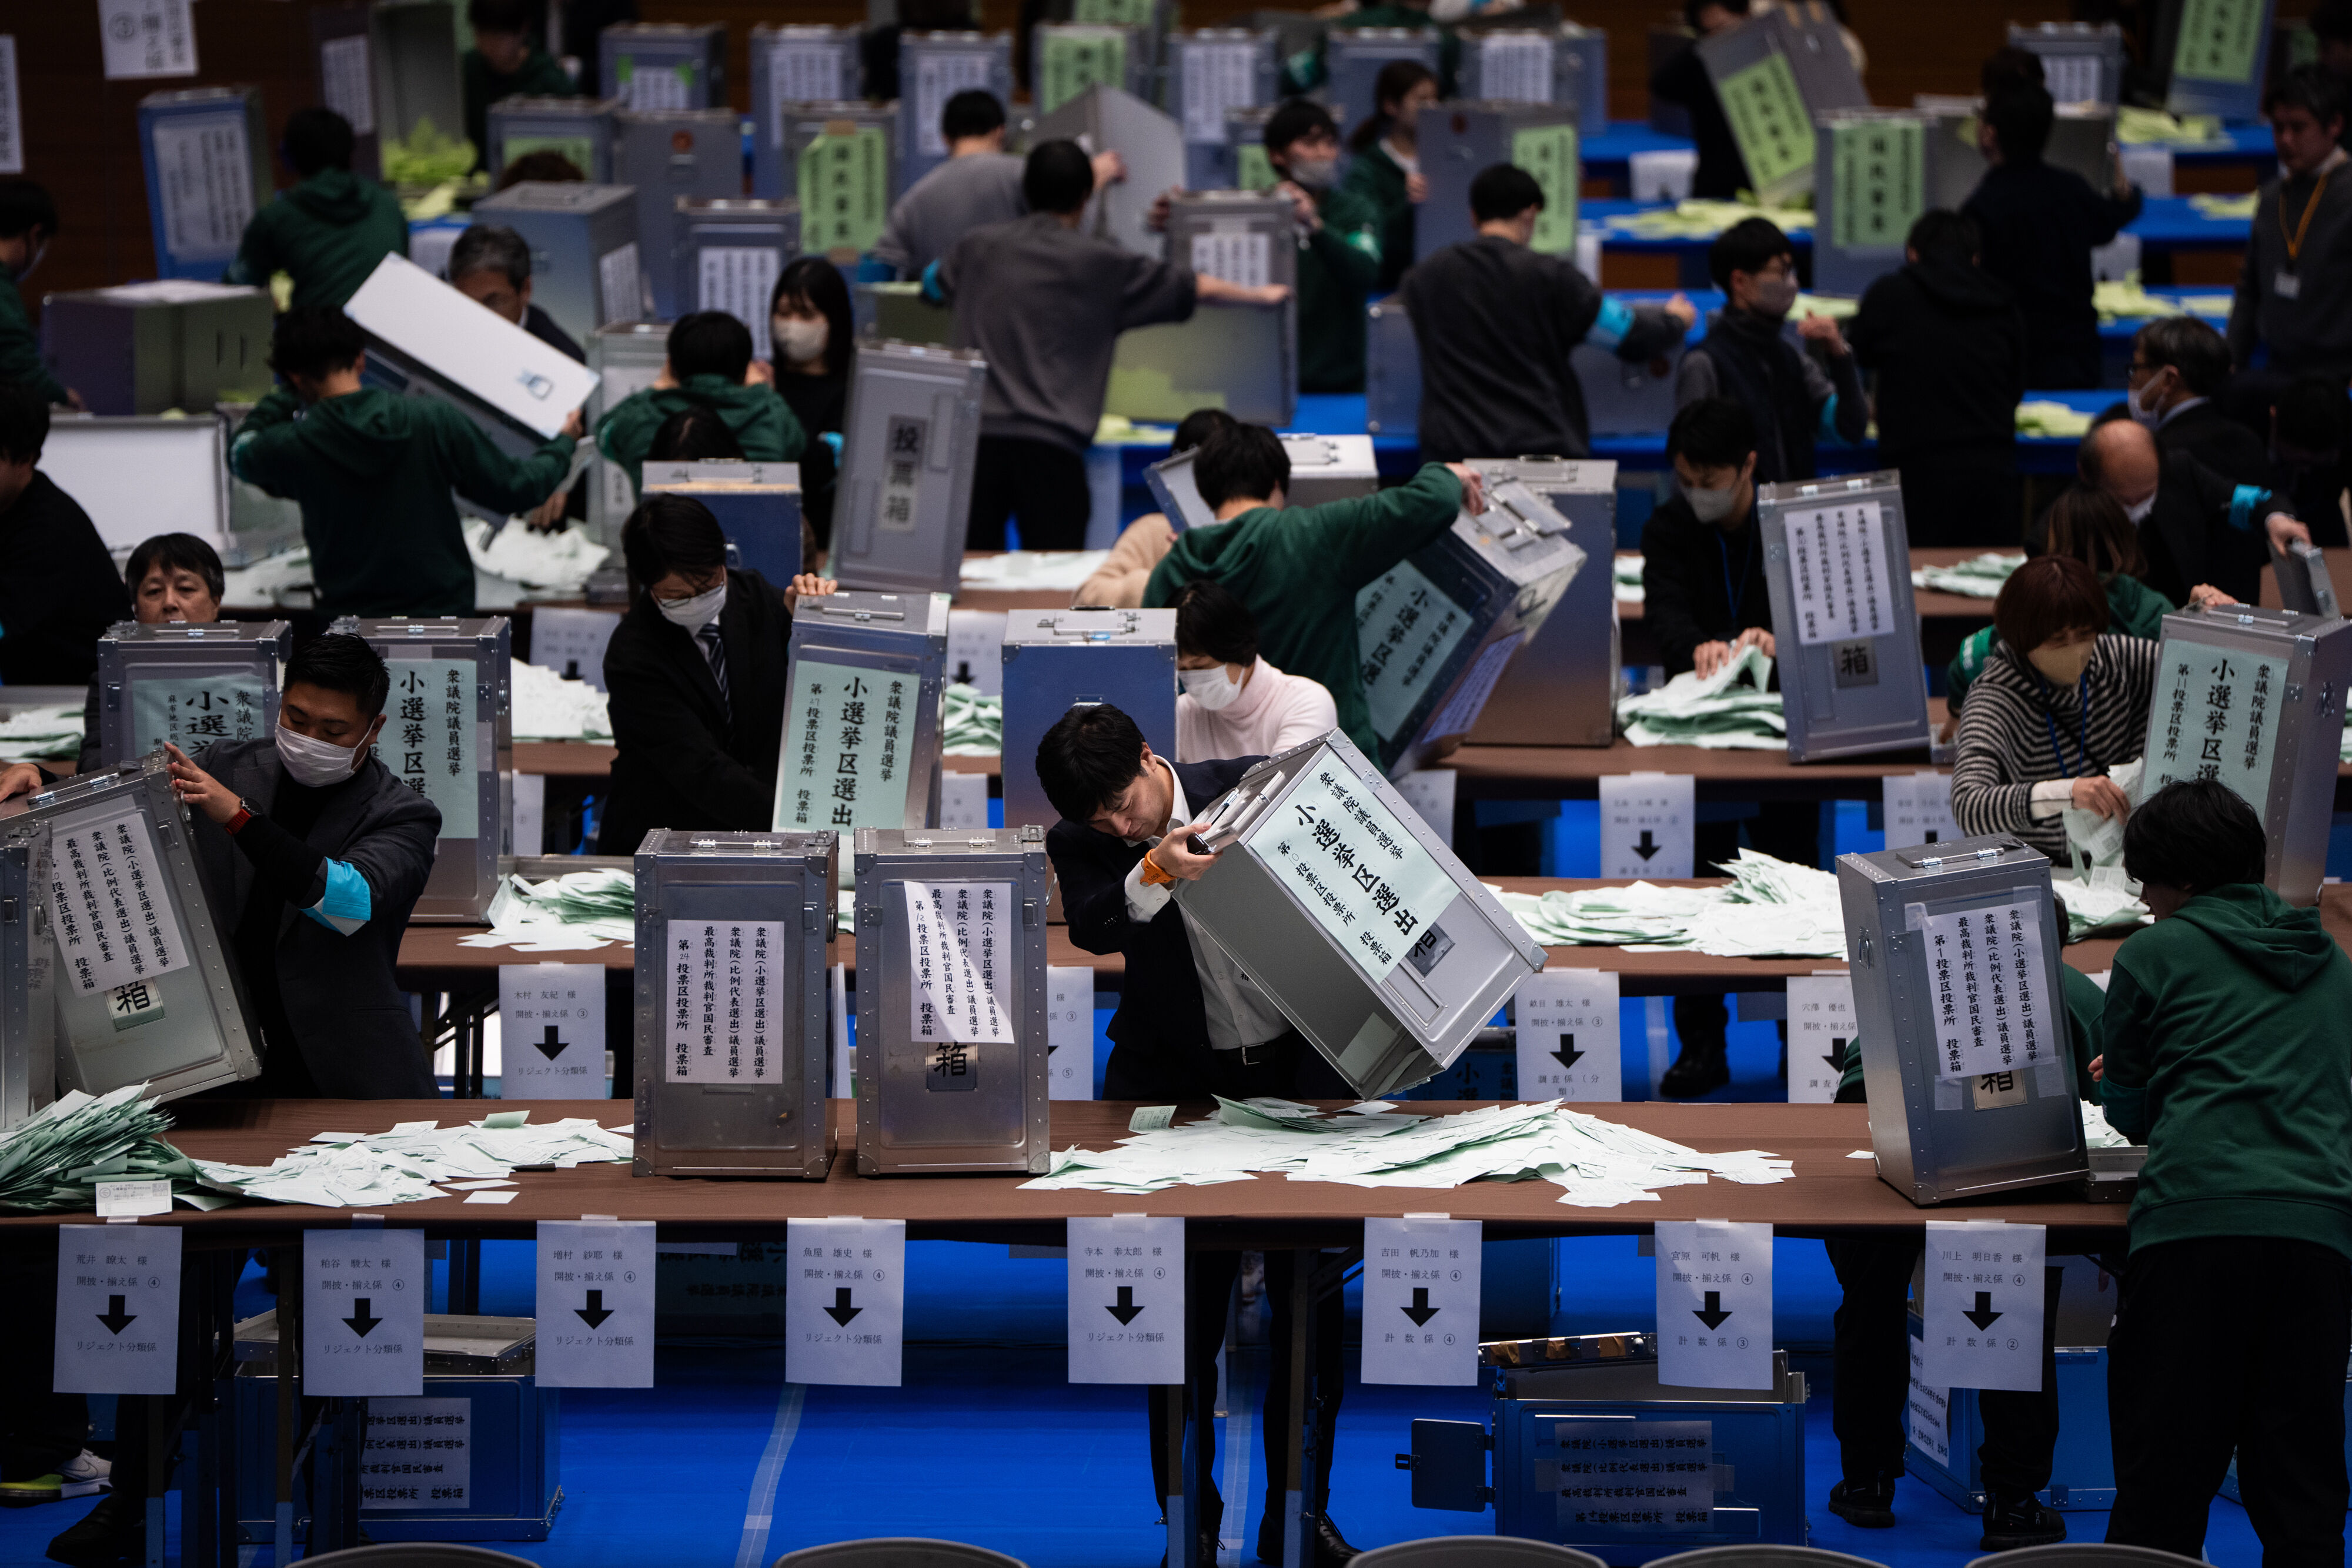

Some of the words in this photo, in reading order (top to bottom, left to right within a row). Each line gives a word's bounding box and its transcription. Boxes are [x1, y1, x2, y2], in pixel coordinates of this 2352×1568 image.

[1841, 645, 1867, 675] 箱
[446, 669, 461, 776] 衆議院議員選挙
[2244, 663, 2270, 770] 衆議院議員選挙
[880, 680, 902, 781] 衆議院議員選挙
[831, 677, 868, 827] 小選挙区選出
[796, 789, 810, 824] 投票箱
[1319, 773, 1403, 860] 衆議院議員選挙
[1295, 805, 1418, 935] 小選挙区選出
[66, 838, 113, 962] 最高裁判所裁判官国民審査
[116, 824, 169, 968] 衆議院（小選挙区選出）議員選挙
[92, 831, 145, 975] 衆議院（比例代表選出）議員選挙
[1278, 841, 1356, 927] 第10投票区投票所
[1359, 931, 1392, 965] 投票箱
[915, 901, 933, 989] 第12投票区投票所
[931, 889, 955, 1015] 最高裁判所裁判官国民審査
[957, 889, 978, 1035] 衆議院（比例代表選出）議員選挙
[982, 889, 998, 1037] 衆議院（小選挙区選出）議員選挙
[75, 957, 95, 989] 投票箱
[676, 940, 690, 1031] 第24投票区投票所
[1958, 917, 1984, 1047] 最高裁判所裁判官国民審査
[2009, 910, 2037, 1061] 衆議院（小選挙区選出）議員選挙
[514, 991, 531, 999] 木村
[540, 991, 558, 999] 友紀
[567, 991, 576, 999] 様
[703, 926, 715, 1056] 最高裁判所裁判官国民審査
[1984, 914, 2013, 1065] 衆議院（比例代表選出）議員選挙
[729, 927, 741, 1078] 衆議院（比例代表選出）議員選挙
[754, 927, 767, 1078] 衆議院（小選挙区選出）議員選挙
[1582, 998, 1590, 1007] 様
[1934, 935, 1956, 1026] 第1投票区投票所
[1947, 1038, 1961, 1072] 投票箱
[516, 1009, 568, 1018] 開披・揃え係
[577, 1008, 587, 1018] ③
[920, 1002, 933, 1035] 投票箱
[1066, 1011, 1077, 1022] ③
[676, 1043, 687, 1076] 投票箱
[517, 1066, 587, 1076] リジェクト分類係
[1063, 1068, 1073, 1079] ⑤
[553, 1251, 573, 1259] 増村
[613, 1251, 622, 1260] 様
[803, 1247, 823, 1258] 魚屋
[833, 1247, 853, 1258] 雄史
[863, 1248, 872, 1258] 様
[1084, 1247, 1103, 1256] 寺本
[1114, 1246, 1142, 1256] 幸太郎
[1152, 1246, 1162, 1256] 様
[1381, 1248, 1399, 1258] 吉田
[1409, 1248, 1439, 1258] 帆乃加
[1449, 1248, 1459, 1259] 様
[1671, 1251, 1690, 1261] 宮原
[1702, 1251, 1720, 1262] 可帆
[1730, 1251, 1740, 1262] 様
[1942, 1250, 1962, 1261] 川上
[1972, 1251, 2002, 1262] 明日香
[2013, 1253, 2022, 1263] 様
[76, 1255, 95, 1265] 荒井
[138, 1255, 147, 1266] 様
[320, 1258, 340, 1269] 粕谷
[381, 1258, 390, 1269] 様
[554, 1271, 614, 1282] 開披・揃え係
[624, 1271, 636, 1283] ④
[804, 1269, 863, 1280] 開披・揃え係
[873, 1269, 884, 1281] ④
[1085, 1268, 1144, 1279] 開披・揃え係
[1154, 1267, 1165, 1279] ④
[1381, 1269, 1440, 1281] 開披・揃え係
[1449, 1269, 1462, 1282] ④
[1673, 1272, 1731, 1283] 開披・揃え係
[1741, 1273, 1753, 1285] ④
[1943, 1272, 2003, 1284] 開披・揃え係
[2013, 1274, 2025, 1286] ④
[76, 1276, 138, 1287] 開披・揃え係
[148, 1277, 160, 1289] ④
[322, 1279, 382, 1290] 開披・揃え係
[392, 1279, 404, 1290] ④
[556, 1336, 634, 1346] リジェクト分類係
[805, 1332, 882, 1345] リジェクト分類係
[1087, 1332, 1164, 1343] リジェクト分類係
[1444, 1334, 1455, 1346] ④
[1737, 1337, 1749, 1349] ③
[76, 1340, 156, 1353] リジェクト分類係
[324, 1343, 402, 1355] リジェクト分類係
[2006, 1339, 2019, 1350] ②
[431, 1488, 464, 1499] 投票箱
[1562, 1487, 1687, 1499] 最高裁判所裁判官国民審査
[1676, 1510, 1708, 1524] 投票箱
